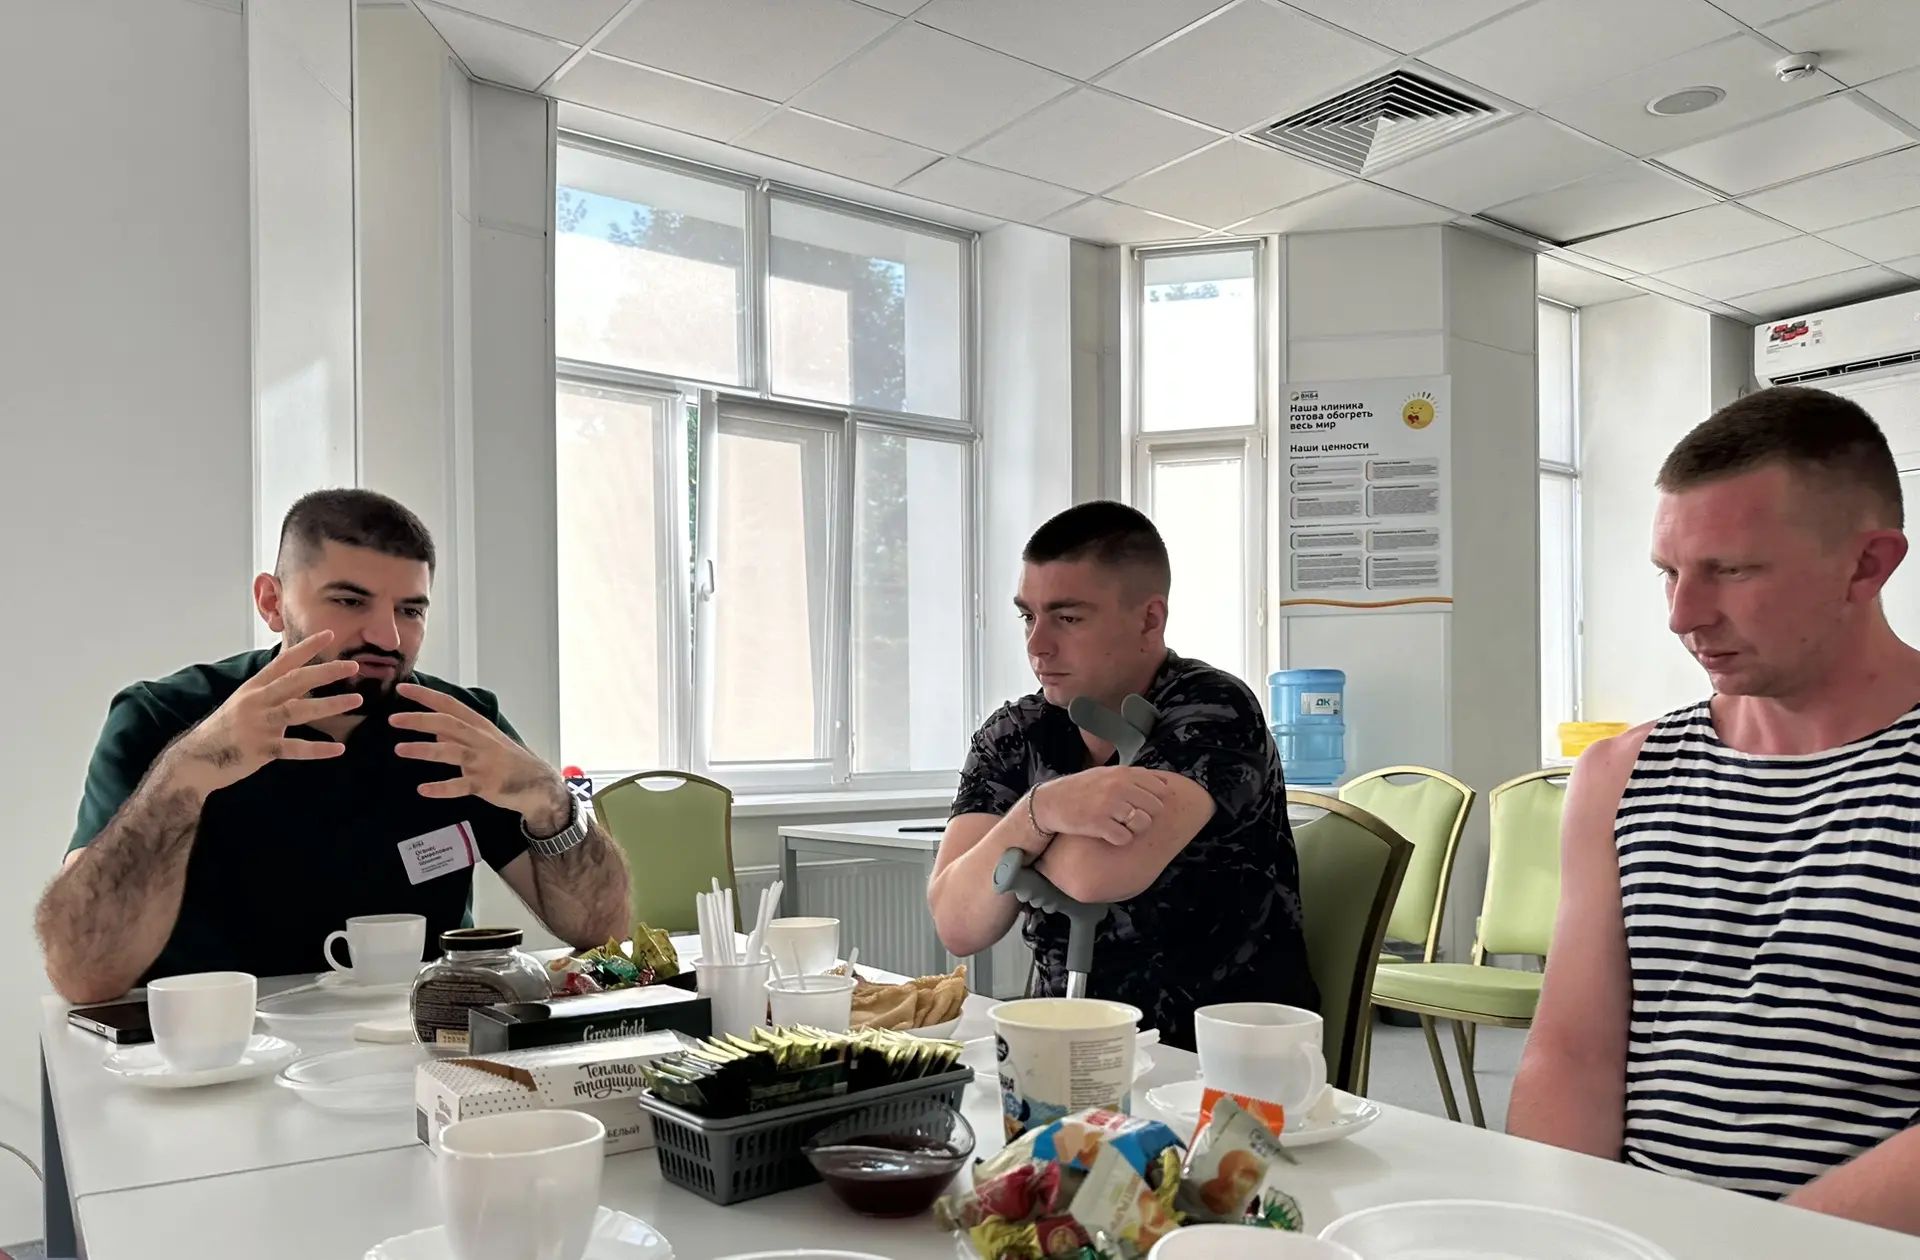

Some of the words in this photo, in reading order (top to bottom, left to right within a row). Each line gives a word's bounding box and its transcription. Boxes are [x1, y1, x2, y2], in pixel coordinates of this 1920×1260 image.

[1290, 404, 1318, 412] Наша
[1321, 402, 1364, 411] клиника
[1290, 413, 1324, 421] готова
[1327, 410, 1373, 420] обогреть
[1290, 422, 1313, 430] весь
[1316, 421, 1336, 430] мир
[1290, 444, 1319, 452] Наши
[1322, 442, 1369, 452] ценности
[583, 1017, 645, 1043] Greenfield
[578, 1062, 636, 1078] Теплые
[573, 1077, 649, 1099] традиции
[607, 1123, 640, 1138] БЕЛЫЙ
